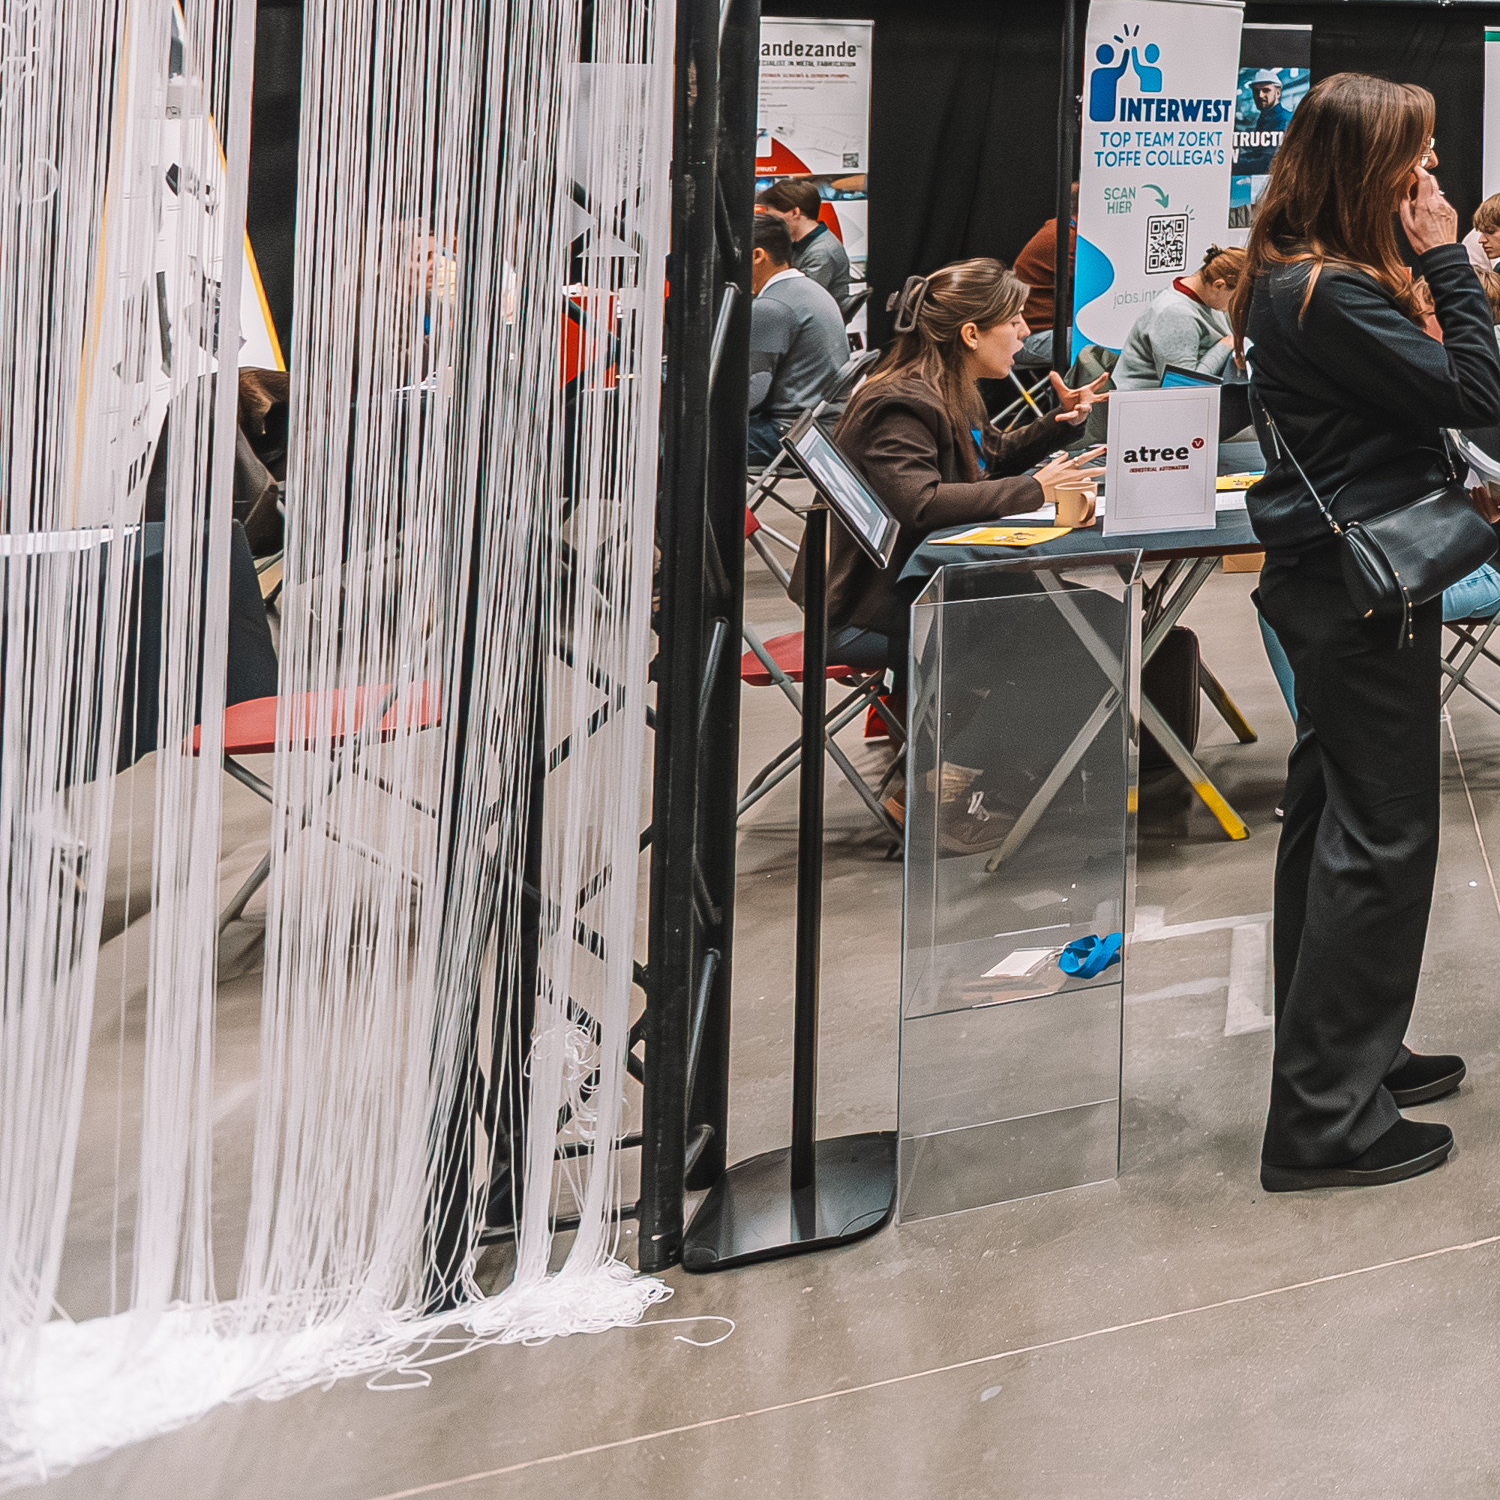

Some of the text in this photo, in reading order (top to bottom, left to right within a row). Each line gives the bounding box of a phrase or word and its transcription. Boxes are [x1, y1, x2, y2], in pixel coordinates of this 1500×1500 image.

[761, 40, 856, 57] andezande
[1119, 97, 1232, 122] INTERWEST
[1100, 131, 1222, 147] TOP TEAM ZOEKT
[1094, 150, 1141, 167] TOFFE
[1145, 149, 1224, 166] COLLEGA'S
[1104, 186, 1136, 201] SCAN
[1106, 201, 1132, 214] HIER
[1124, 446, 1189, 463] atree
